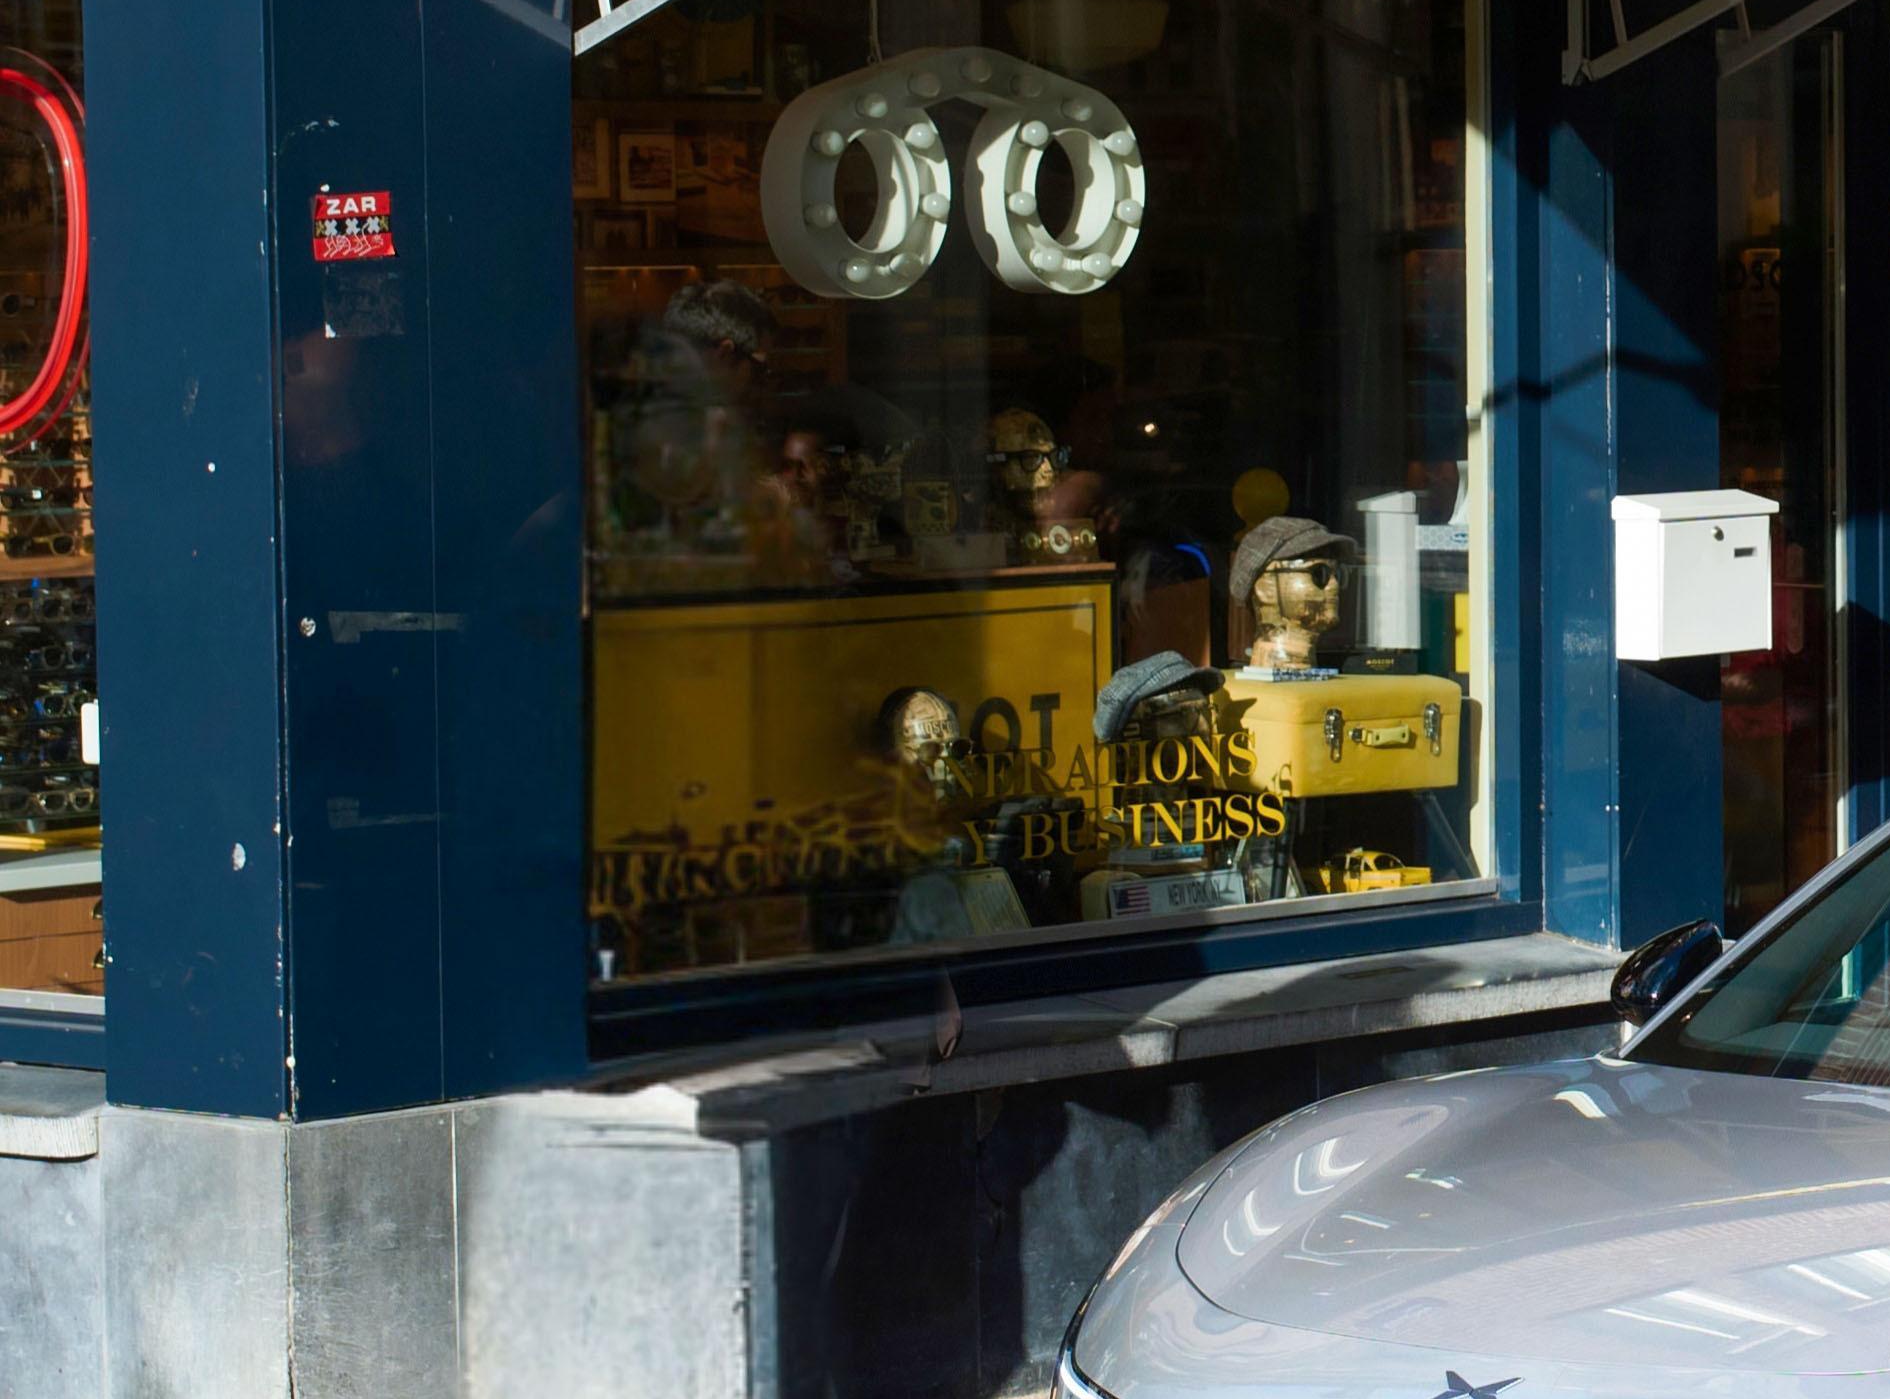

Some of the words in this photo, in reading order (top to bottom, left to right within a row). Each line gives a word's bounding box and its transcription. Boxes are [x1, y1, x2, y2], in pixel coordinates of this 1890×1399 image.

[326, 196, 376, 215] ZAR
[943, 730, 1258, 801] NERATIONS
[1018, 790, 1287, 862] BUSINESS
